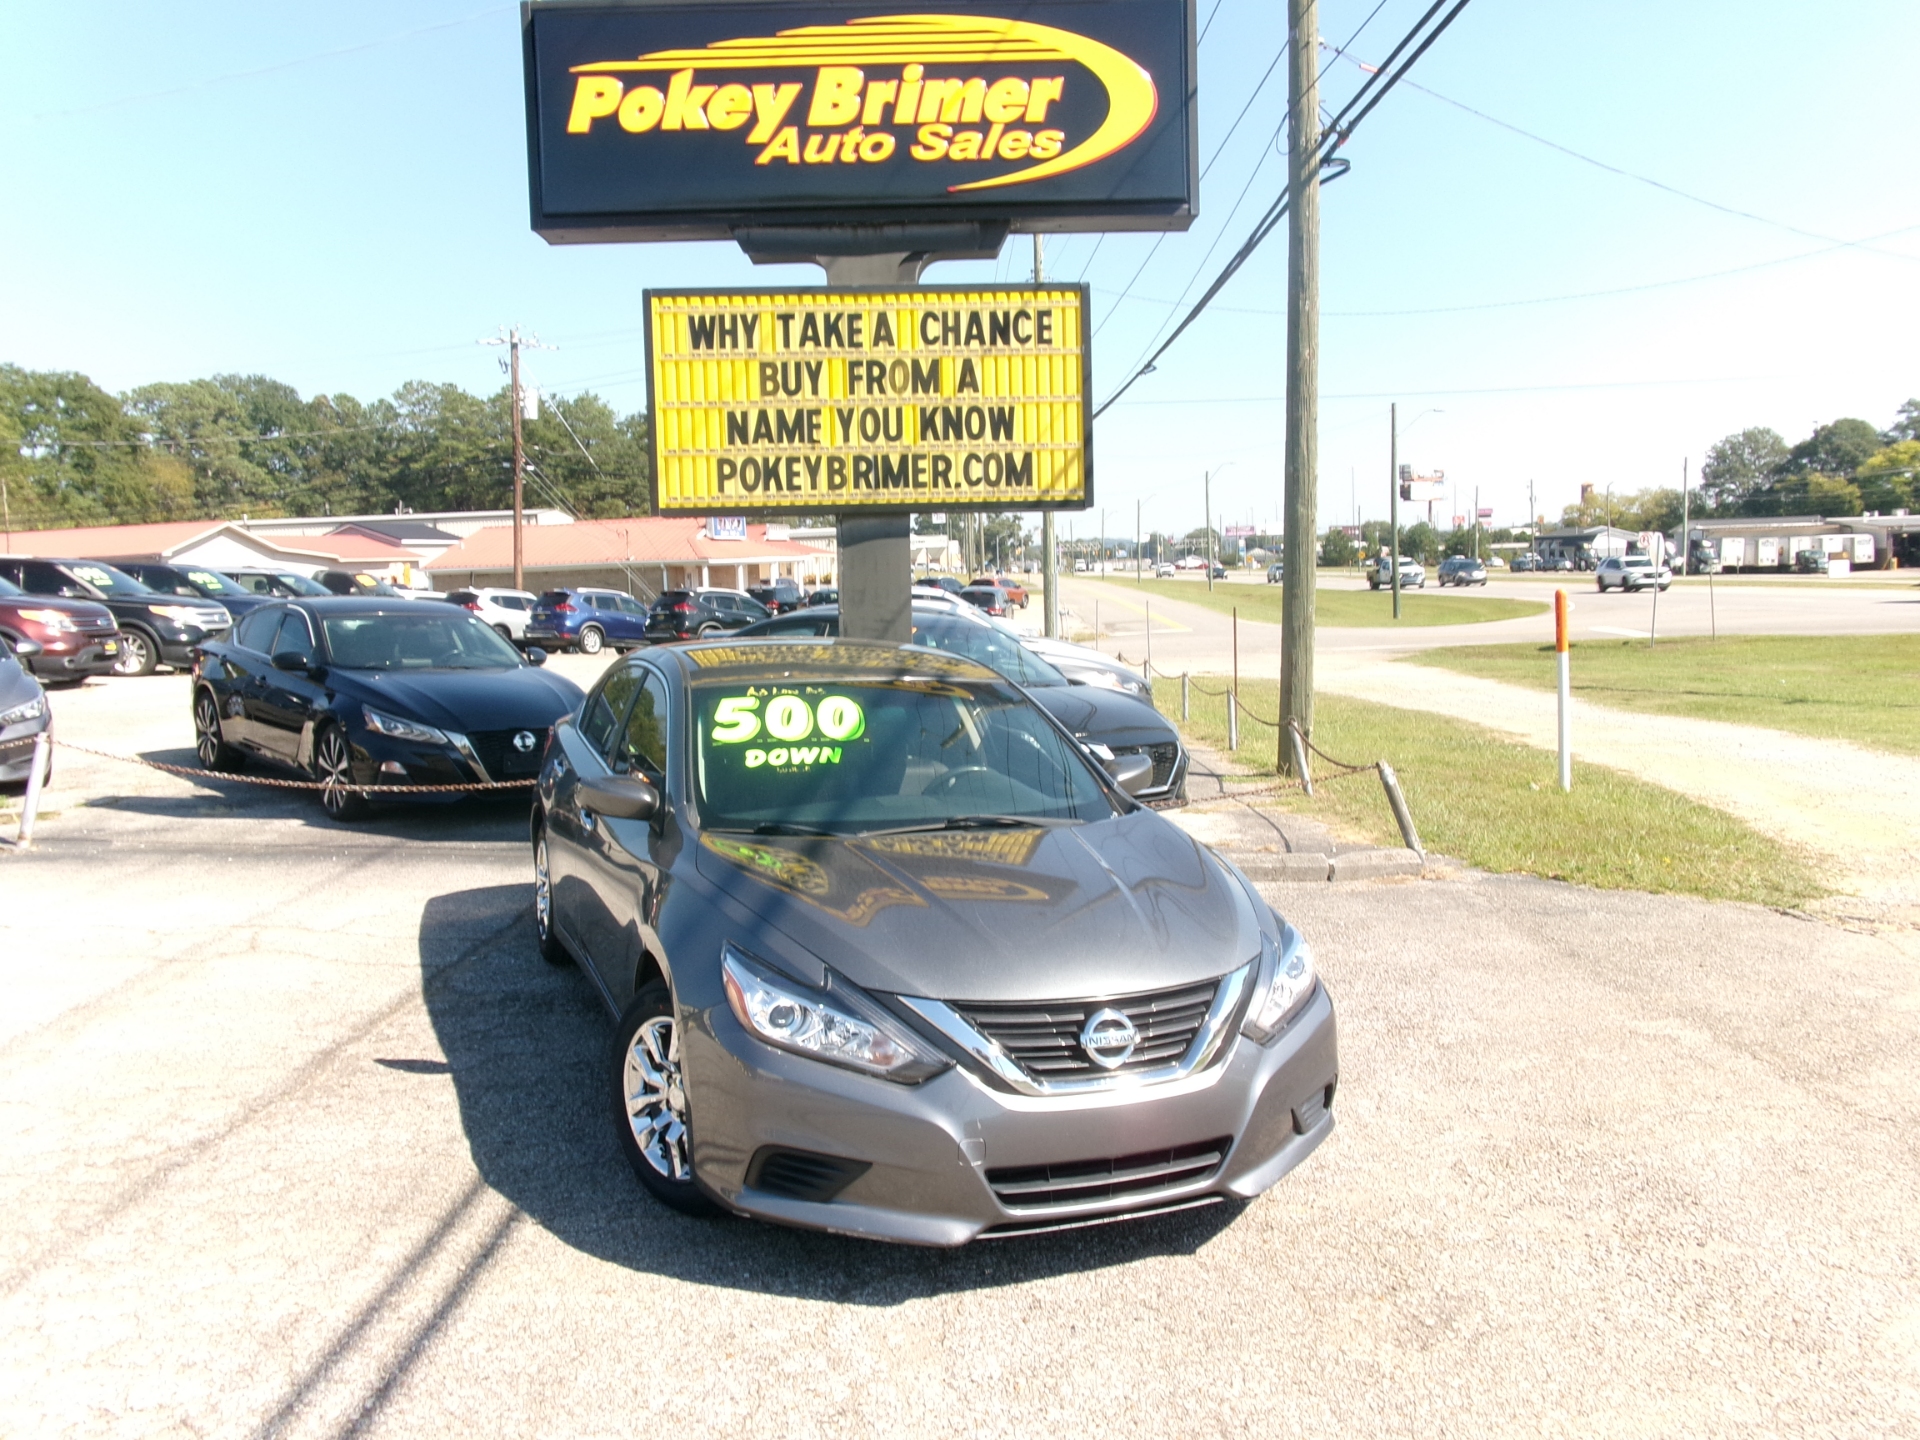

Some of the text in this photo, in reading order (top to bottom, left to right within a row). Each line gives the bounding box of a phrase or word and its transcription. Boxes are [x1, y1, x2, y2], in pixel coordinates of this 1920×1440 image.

[567, 63, 1065, 144] Pokey Brimer
[754, 123, 1065, 165] Auto Sales
[688, 309, 1053, 350] WHY TAKE A CHANCE
[760, 358, 980, 397] BUY FROM A
[727, 405, 1016, 446] NAME YOU KNOW
[717, 452, 1034, 493] POKEYBRIMER.COM
[711, 694, 866, 744] 500
[744, 746, 843, 769] DOWN
[1087, 1032, 1136, 1047] NISSAN
